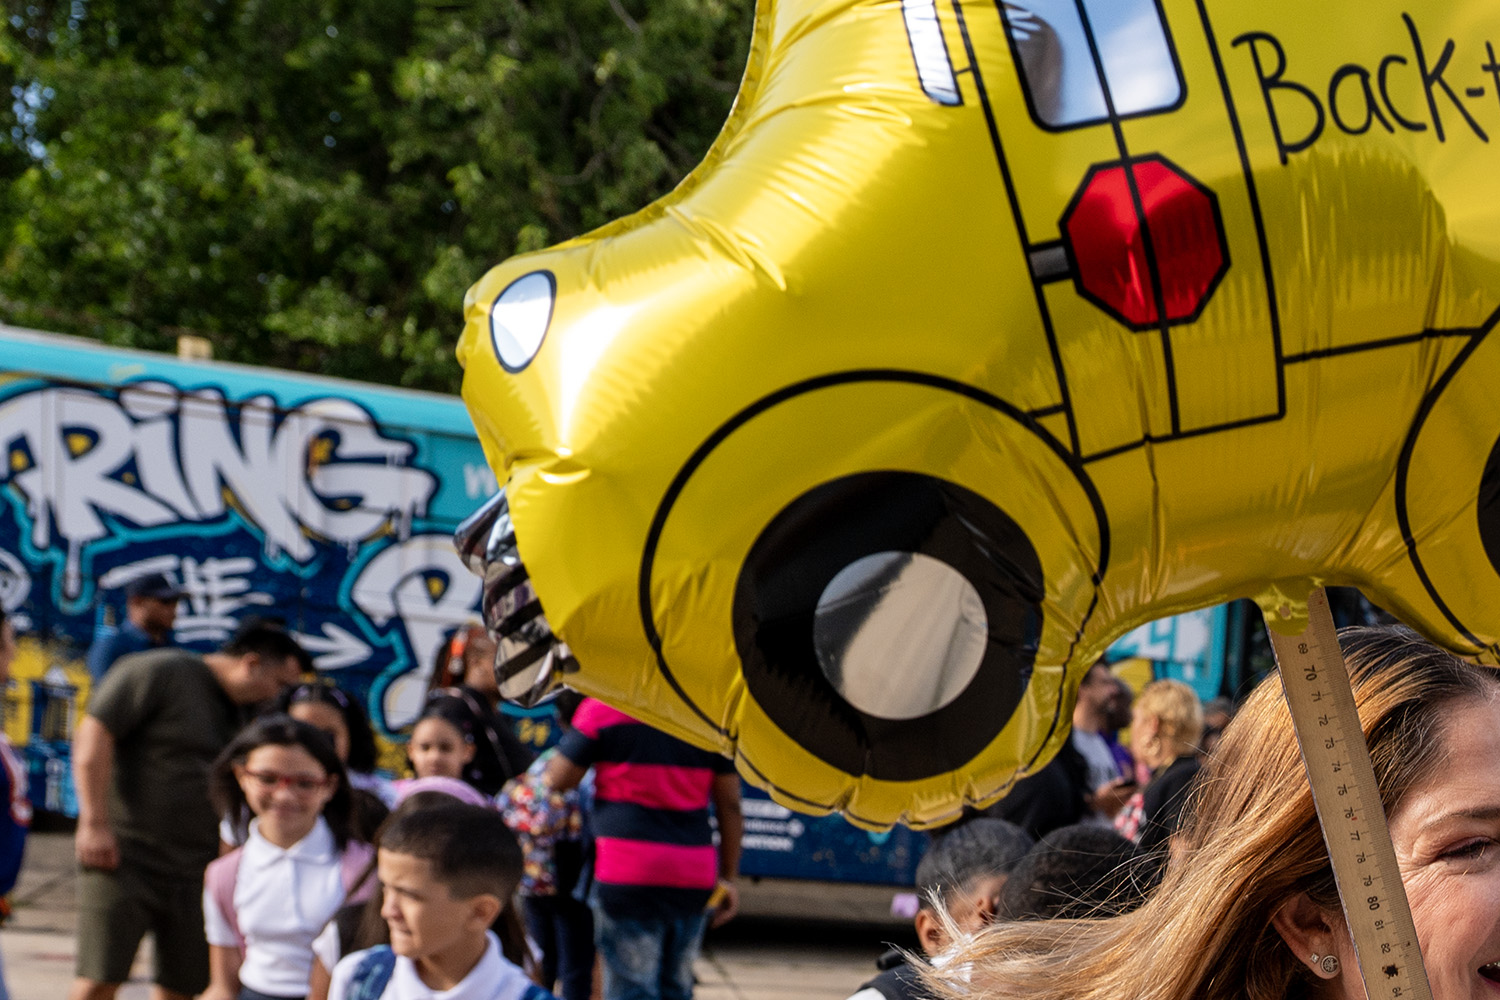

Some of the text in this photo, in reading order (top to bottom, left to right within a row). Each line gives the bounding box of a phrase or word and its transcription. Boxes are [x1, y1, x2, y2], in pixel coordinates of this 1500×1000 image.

[1297, 642, 1308, 655] 69
[1303, 665, 1317, 681] 70
[1311, 691, 1322, 702] 71
[1318, 714, 1329, 727] 72
[1324, 737, 1335, 750] 73
[1331, 760, 1341, 773] 74
[1337, 783, 1348, 796] 75
[1343, 806, 1354, 819] 76
[1350, 830, 1361, 842] 77
[1355, 852, 1366, 864] 78
[1362, 874, 1373, 887] 79
[1367, 896, 1380, 911] 80
[1380, 943, 1391, 954] 82
